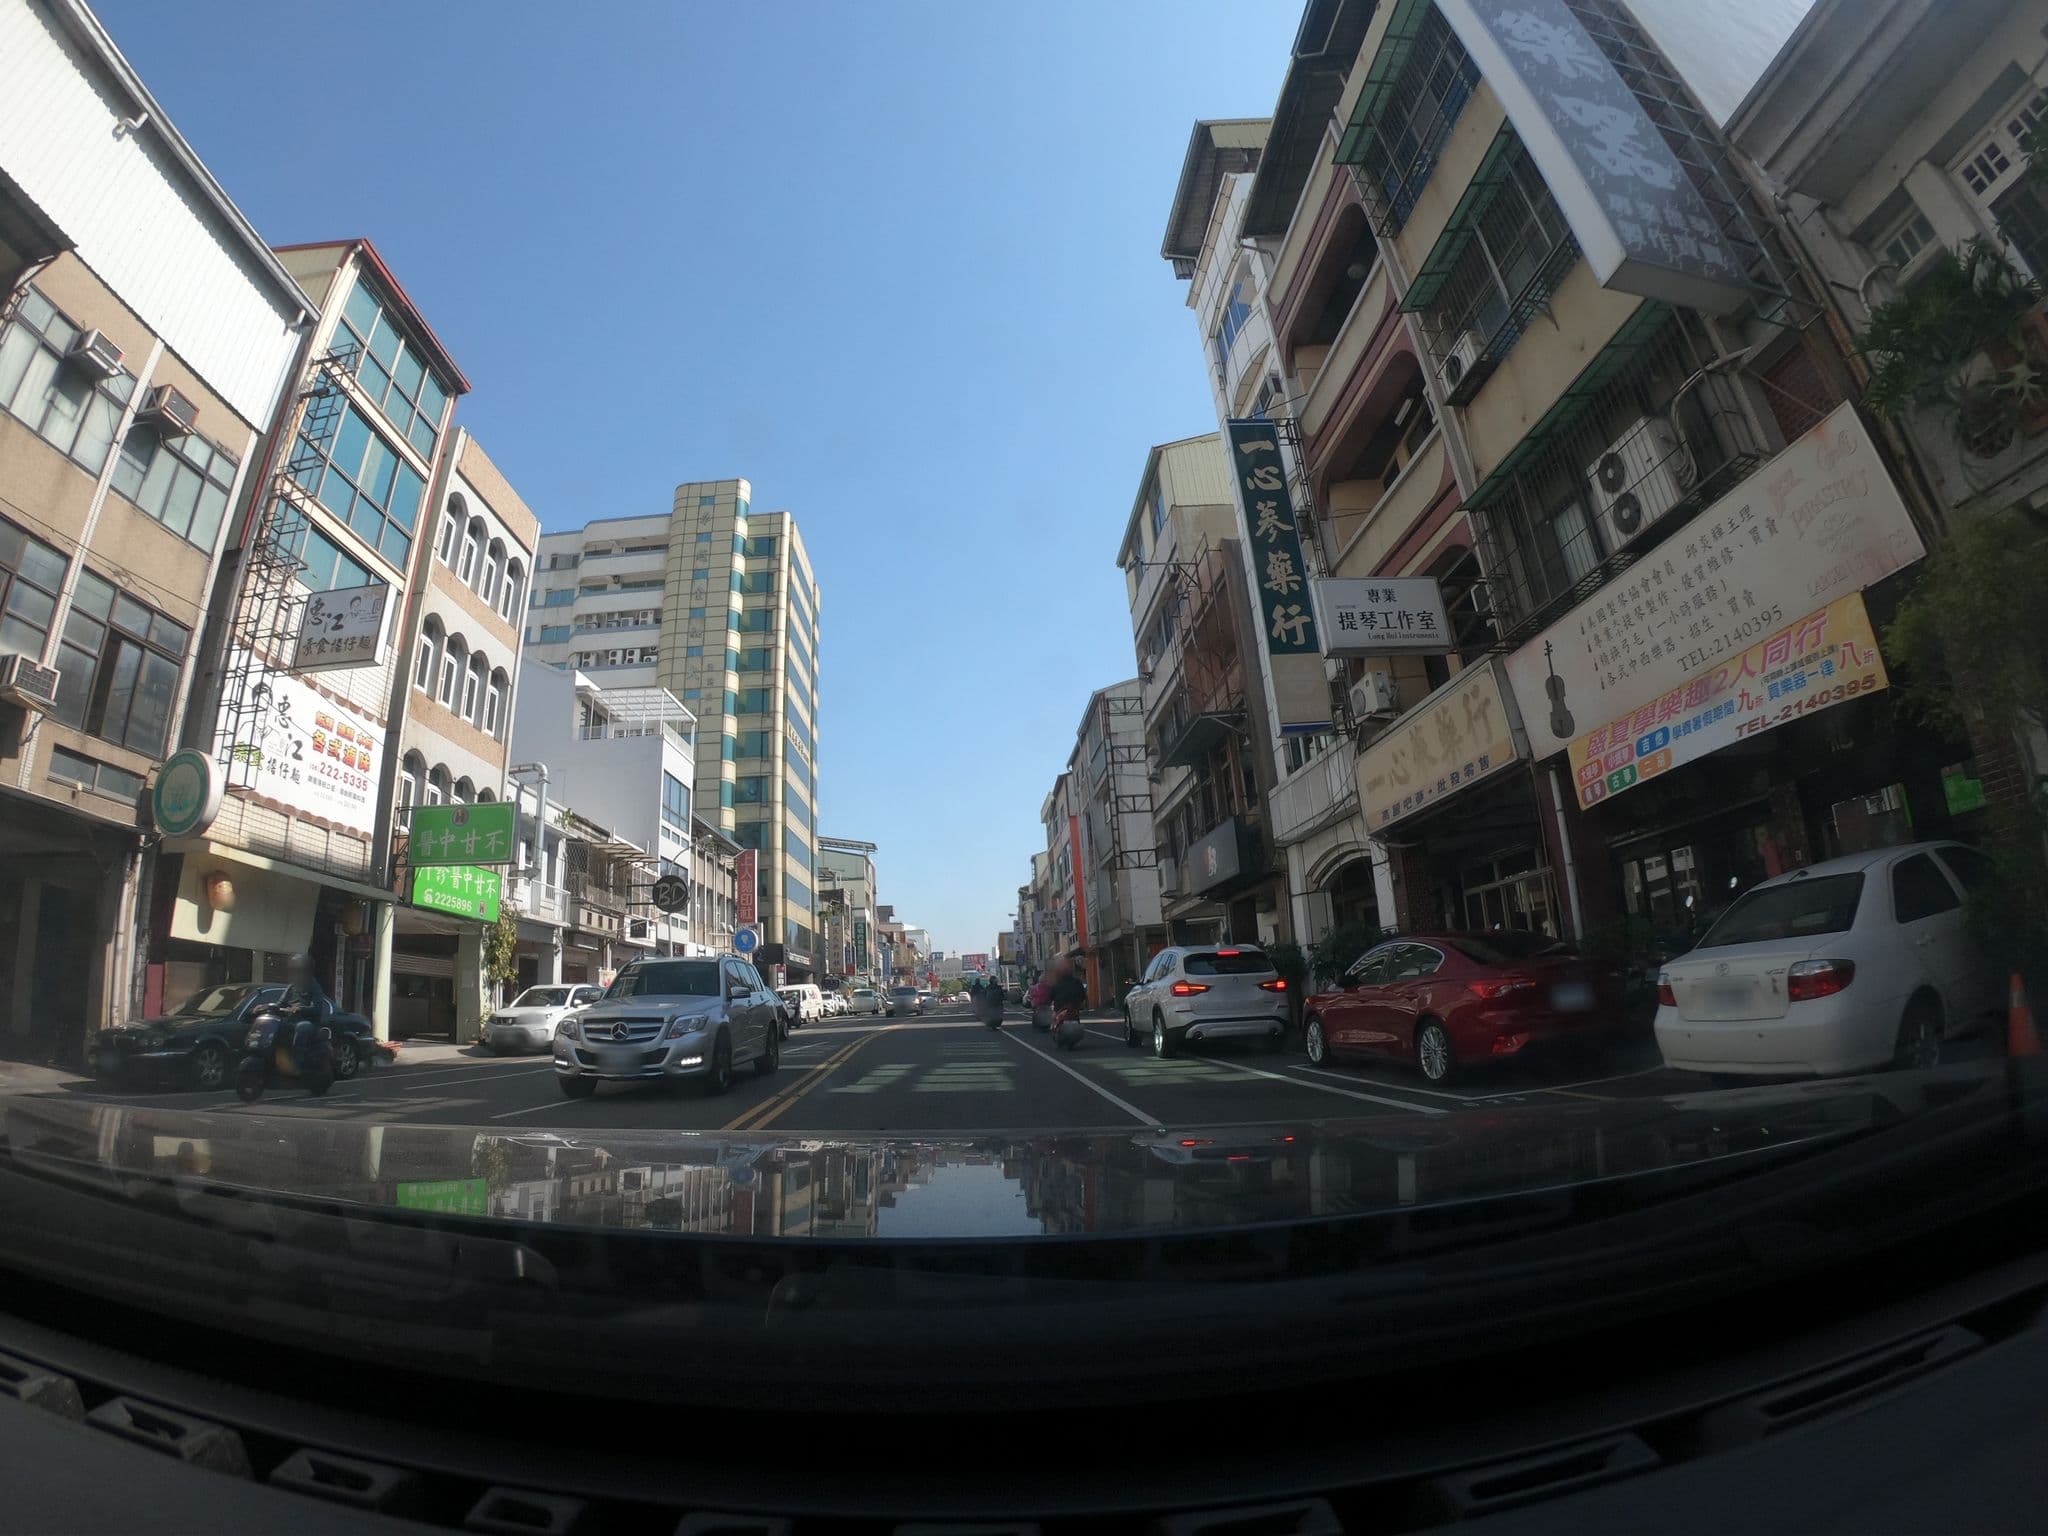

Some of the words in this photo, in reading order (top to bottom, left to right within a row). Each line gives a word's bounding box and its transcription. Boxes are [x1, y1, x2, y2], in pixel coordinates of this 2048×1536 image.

[1337, 609, 1437, 632] 提琴工作室
[434, 891, 473, 912] 2225896
